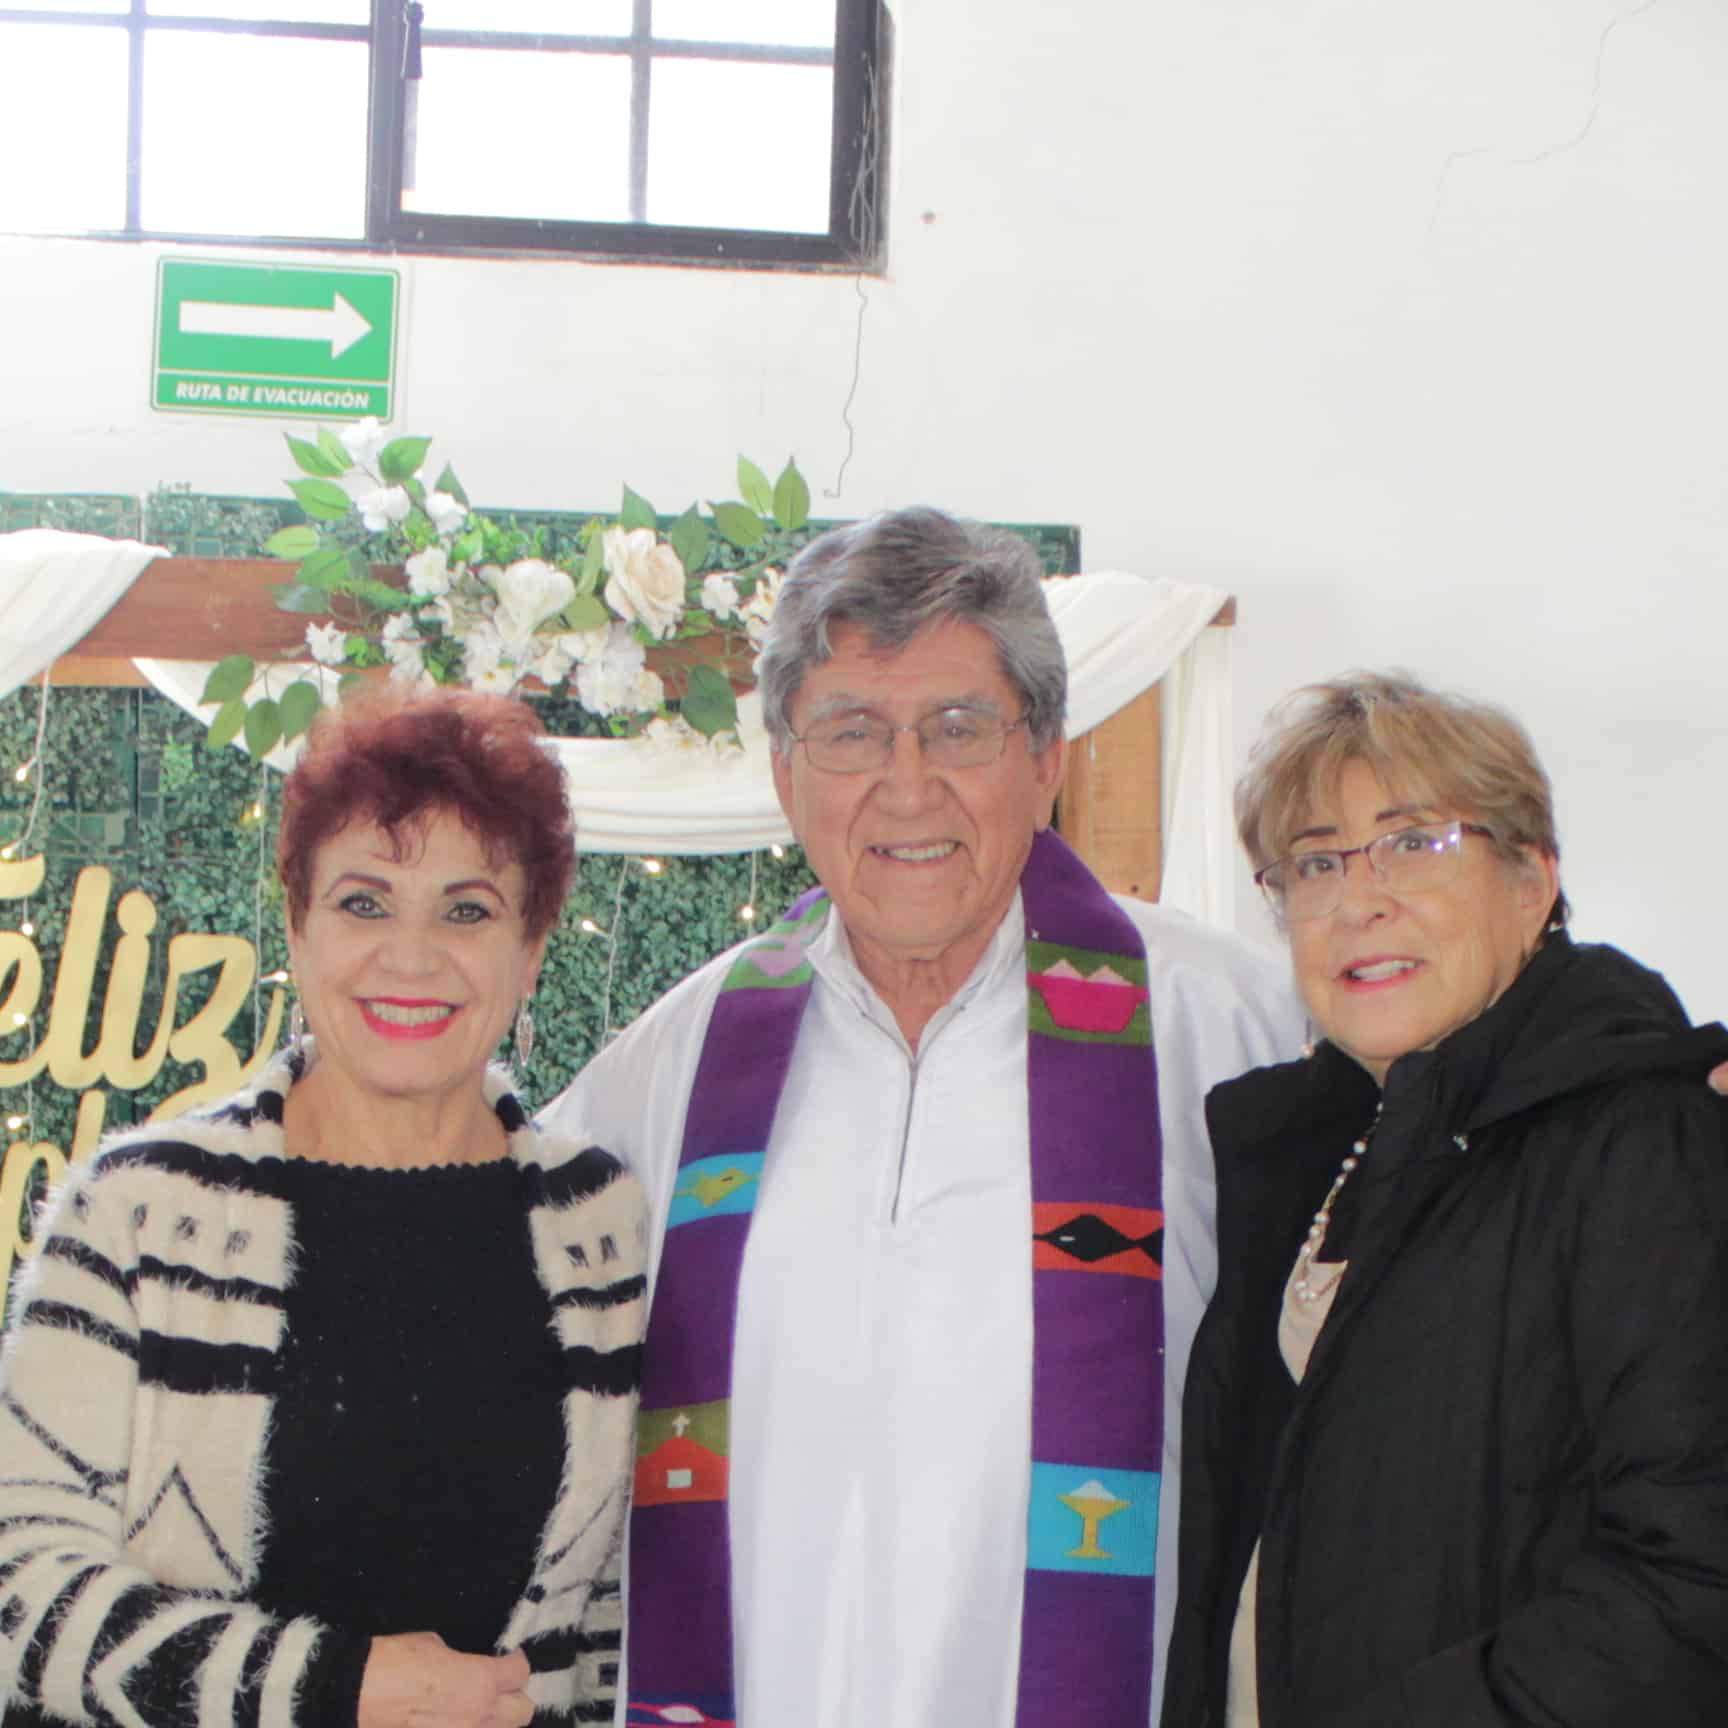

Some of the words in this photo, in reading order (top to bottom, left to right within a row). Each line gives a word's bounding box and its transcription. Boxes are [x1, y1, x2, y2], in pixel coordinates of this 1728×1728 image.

[176, 382, 222, 401] RUTA
[226, 384, 249, 402] DE
[253, 386, 370, 410] EVACUACIÓN
